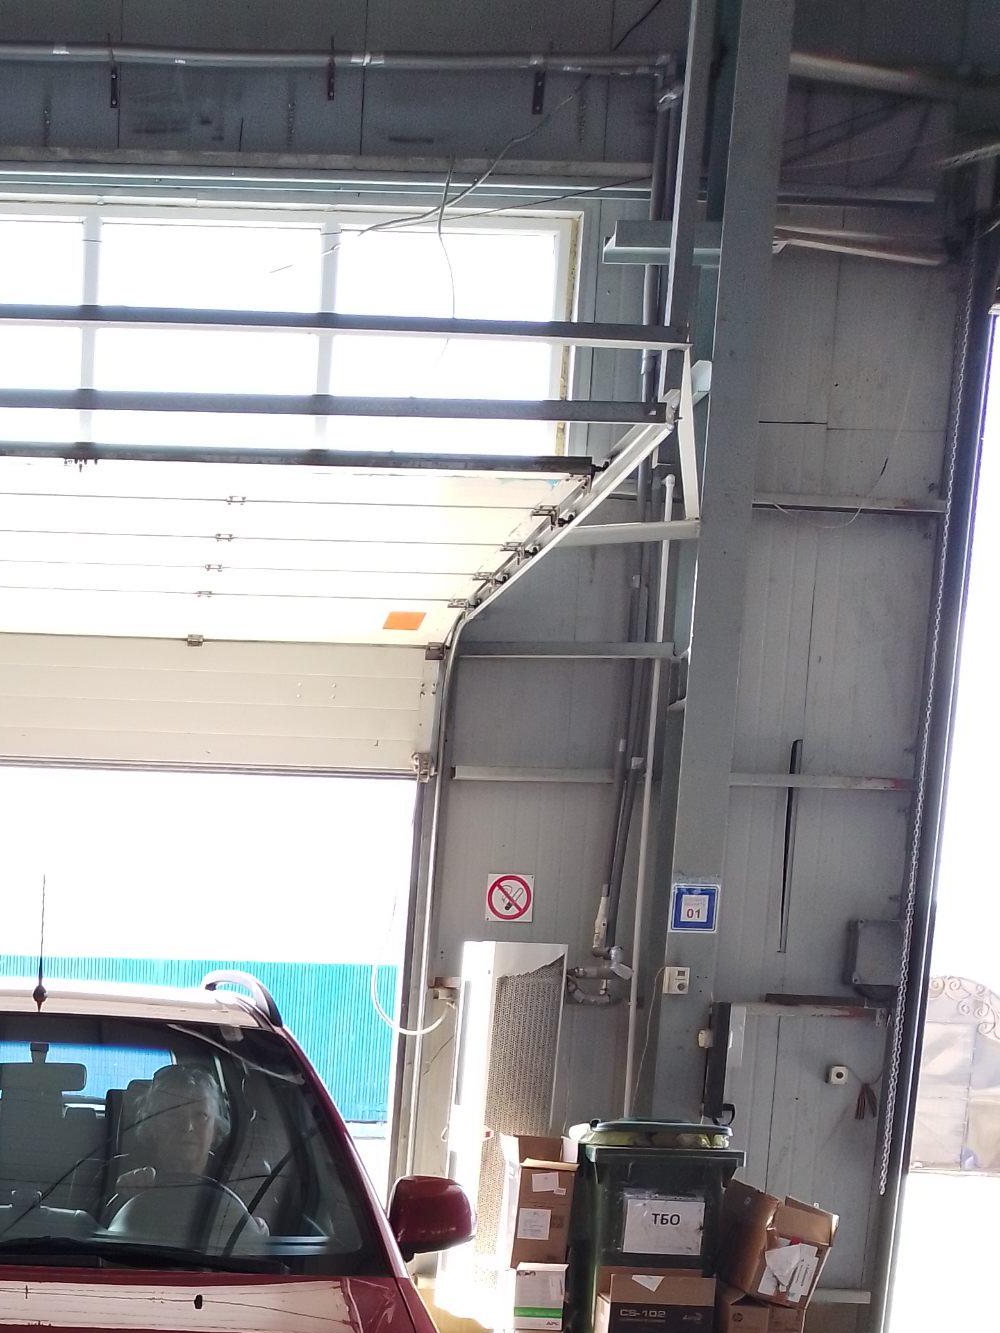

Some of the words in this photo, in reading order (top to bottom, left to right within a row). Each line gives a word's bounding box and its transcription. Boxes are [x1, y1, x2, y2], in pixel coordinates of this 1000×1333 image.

[686, 908, 701, 919] 01
[651, 1212, 681, 1226] ТБО
[619, 1308, 666, 1318] CS-102
